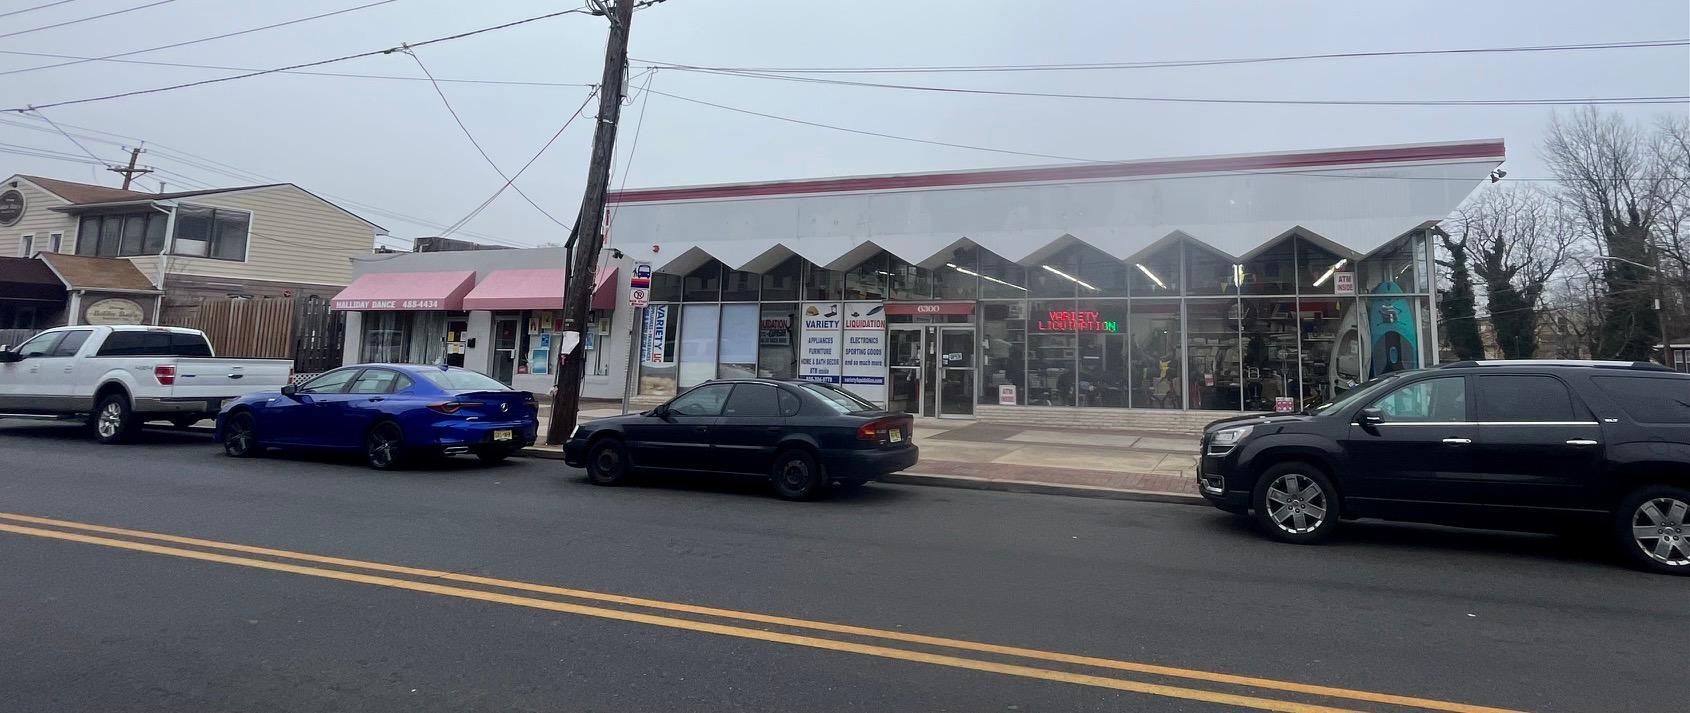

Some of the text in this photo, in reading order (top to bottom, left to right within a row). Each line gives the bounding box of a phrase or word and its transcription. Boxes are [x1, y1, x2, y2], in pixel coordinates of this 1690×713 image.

[335, 300, 438, 309] HALLIDAY DANCE 488-4434
[1049, 312, 1099, 321] VARIETY
[654, 305, 666, 350] VARIETY
[805, 320, 840, 329] VARIETY
[845, 319, 886, 328] LIQUIDATION
